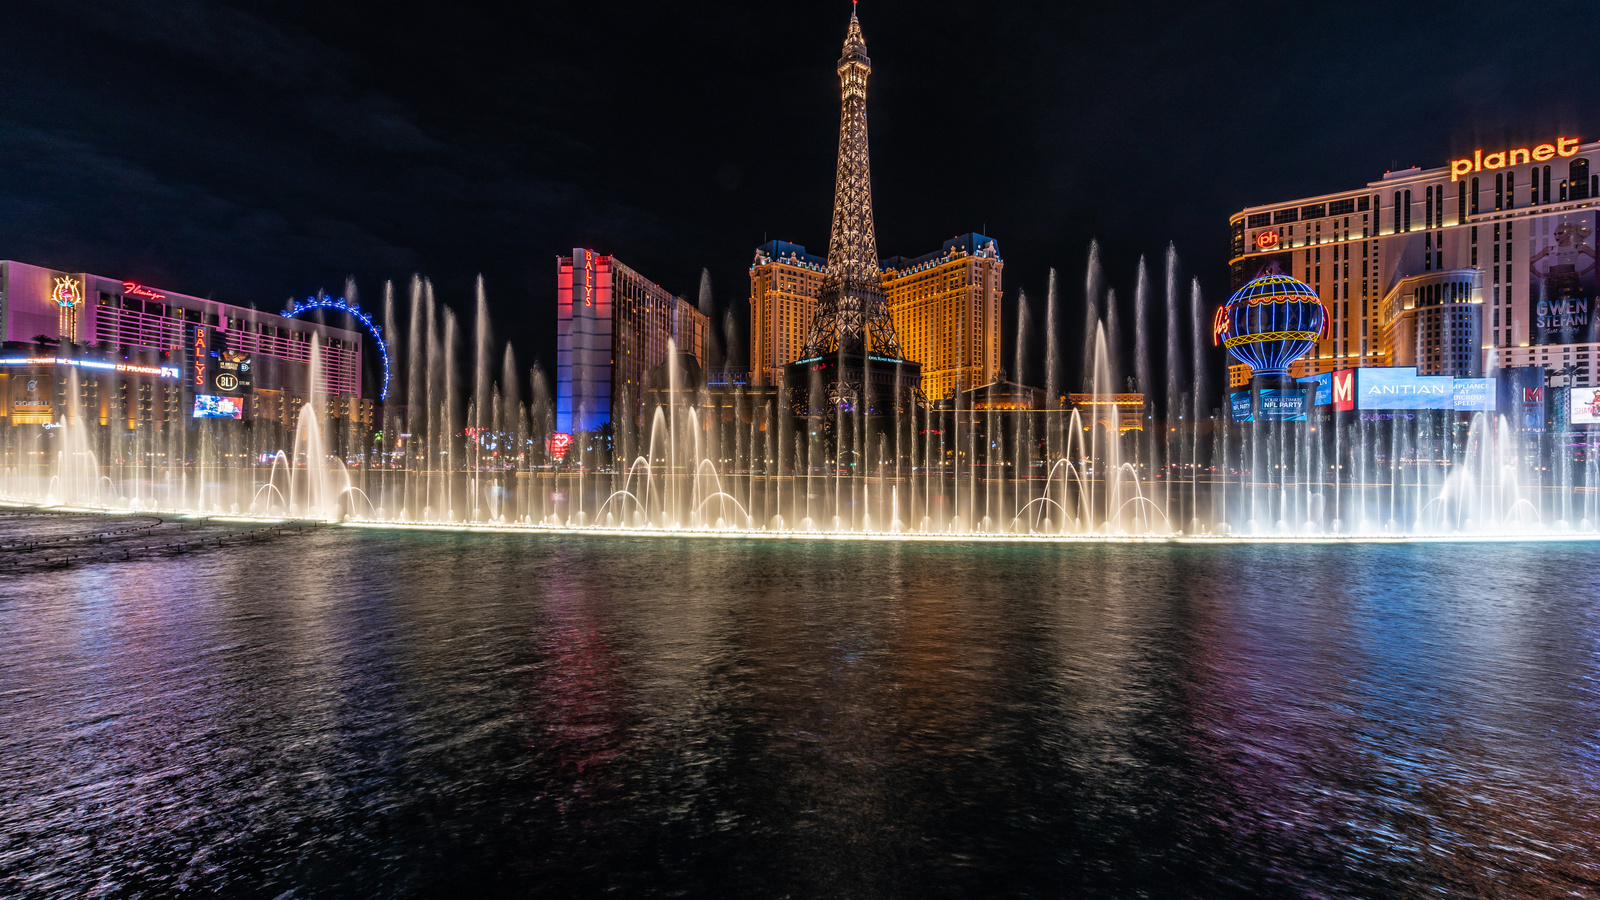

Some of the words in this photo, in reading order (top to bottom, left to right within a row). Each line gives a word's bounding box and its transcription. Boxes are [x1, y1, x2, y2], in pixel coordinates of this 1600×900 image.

[1451, 136, 1579, 182] planet
[584, 250, 593, 307] BALLYS
[122, 282, 166, 300] Flamingo
[1536, 297, 1588, 316] GWEN
[1536, 312, 1588, 328] STEFANI
[194, 328, 206, 385] BALLYS
[220, 376, 234, 387] BLT
[1334, 372, 1352, 403] M
[1368, 384, 1445, 395] ANITIAN
[1263, 401, 1278, 409] NFL
[1279, 401, 1303, 409] PARTY
